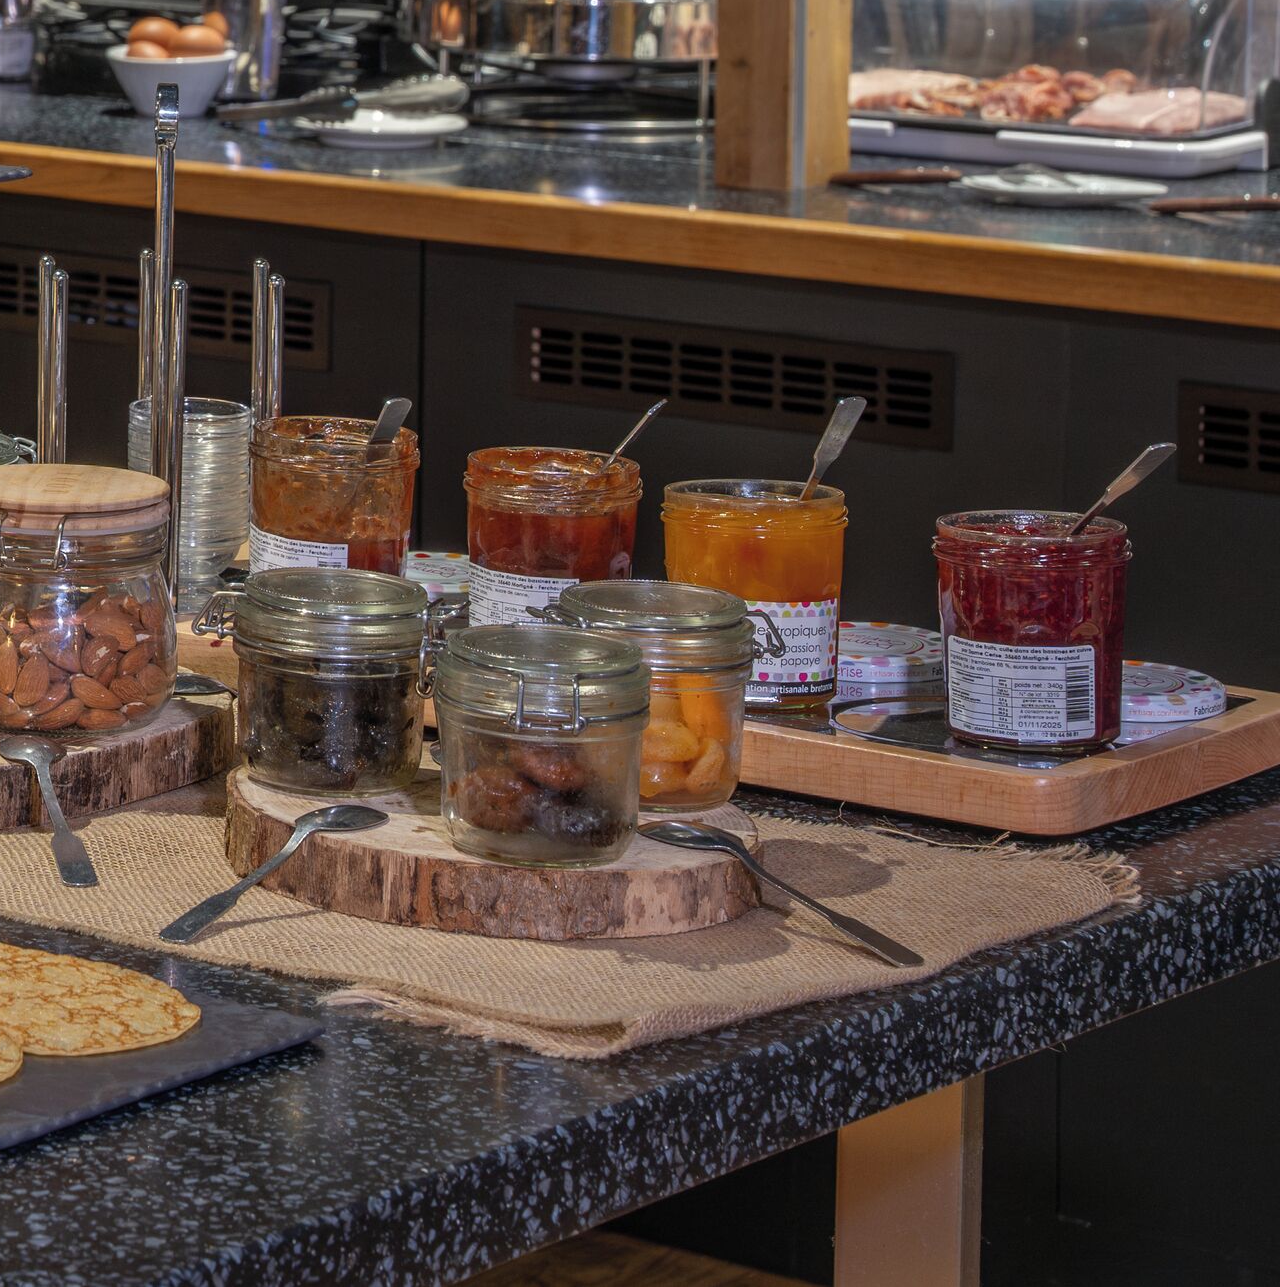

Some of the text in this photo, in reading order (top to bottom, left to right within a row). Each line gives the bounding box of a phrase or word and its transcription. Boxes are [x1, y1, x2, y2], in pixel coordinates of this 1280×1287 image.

[780, 657, 821, 669] papaye
[770, 685, 809, 694] artisanale
[1047, 682, 1063, 690] 340g
[974, 726, 1019, 736] damecerise.com
